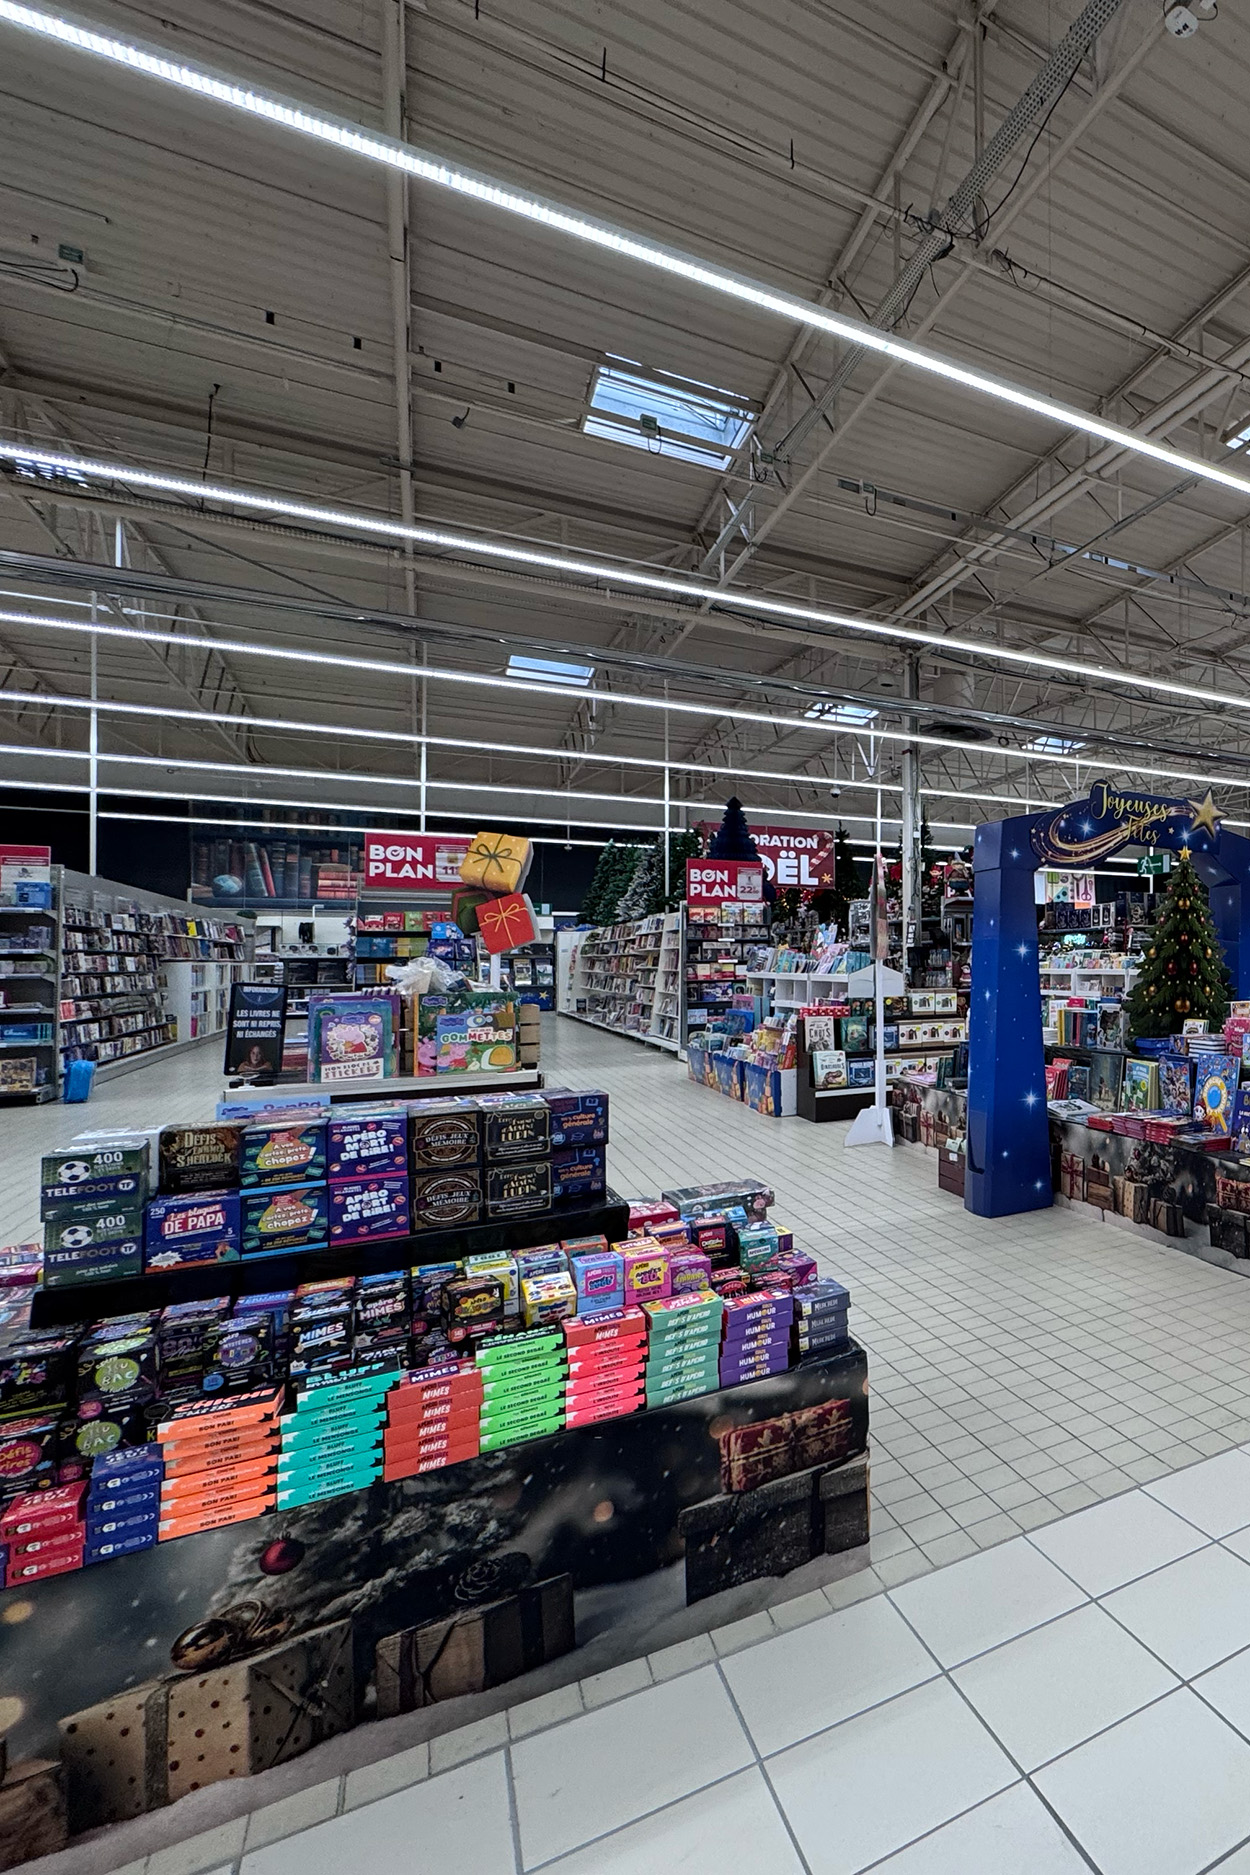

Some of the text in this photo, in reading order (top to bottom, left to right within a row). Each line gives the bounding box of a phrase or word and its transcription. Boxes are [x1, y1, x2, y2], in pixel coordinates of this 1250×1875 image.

[1091, 783, 1172, 822] Joyeuses
[1121, 814, 1161, 844] Fêtes
[369, 844, 423, 862] BON
[369, 862, 433, 879] PLAN
[690, 869, 728, 882] BON
[690, 883, 737, 897] PLAN
[233, 1020, 250, 1028] SONT
[245, 1029, 277, 1038] ÉCHANGÉS
[441, 1032, 512, 1043] GOMMETTES
[325, 1065, 380, 1079] STICKERS
[563, 1119, 594, 1129] générale
[344, 1130, 387, 1144] APÉRO
[94, 1152, 123, 1164] 400
[265, 1154, 306, 1166] chopez
[340, 1151, 358, 1161] DE
[345, 1189, 389, 1205] APÉRO
[150, 1207, 166, 1215] 250
[342, 1213, 360, 1222] DE
[96, 1215, 125, 1229] 400
[164, 1212, 224, 1234] DE PAPA
[268, 1216, 308, 1228] chopez
[227, 1227, 233, 1235] 5
[360, 1302, 402, 1320] MIMES
[584, 1311, 624, 1325] MIMES
[300, 1322, 344, 1342] MIMES
[411, 1365, 458, 1382] MIMES
